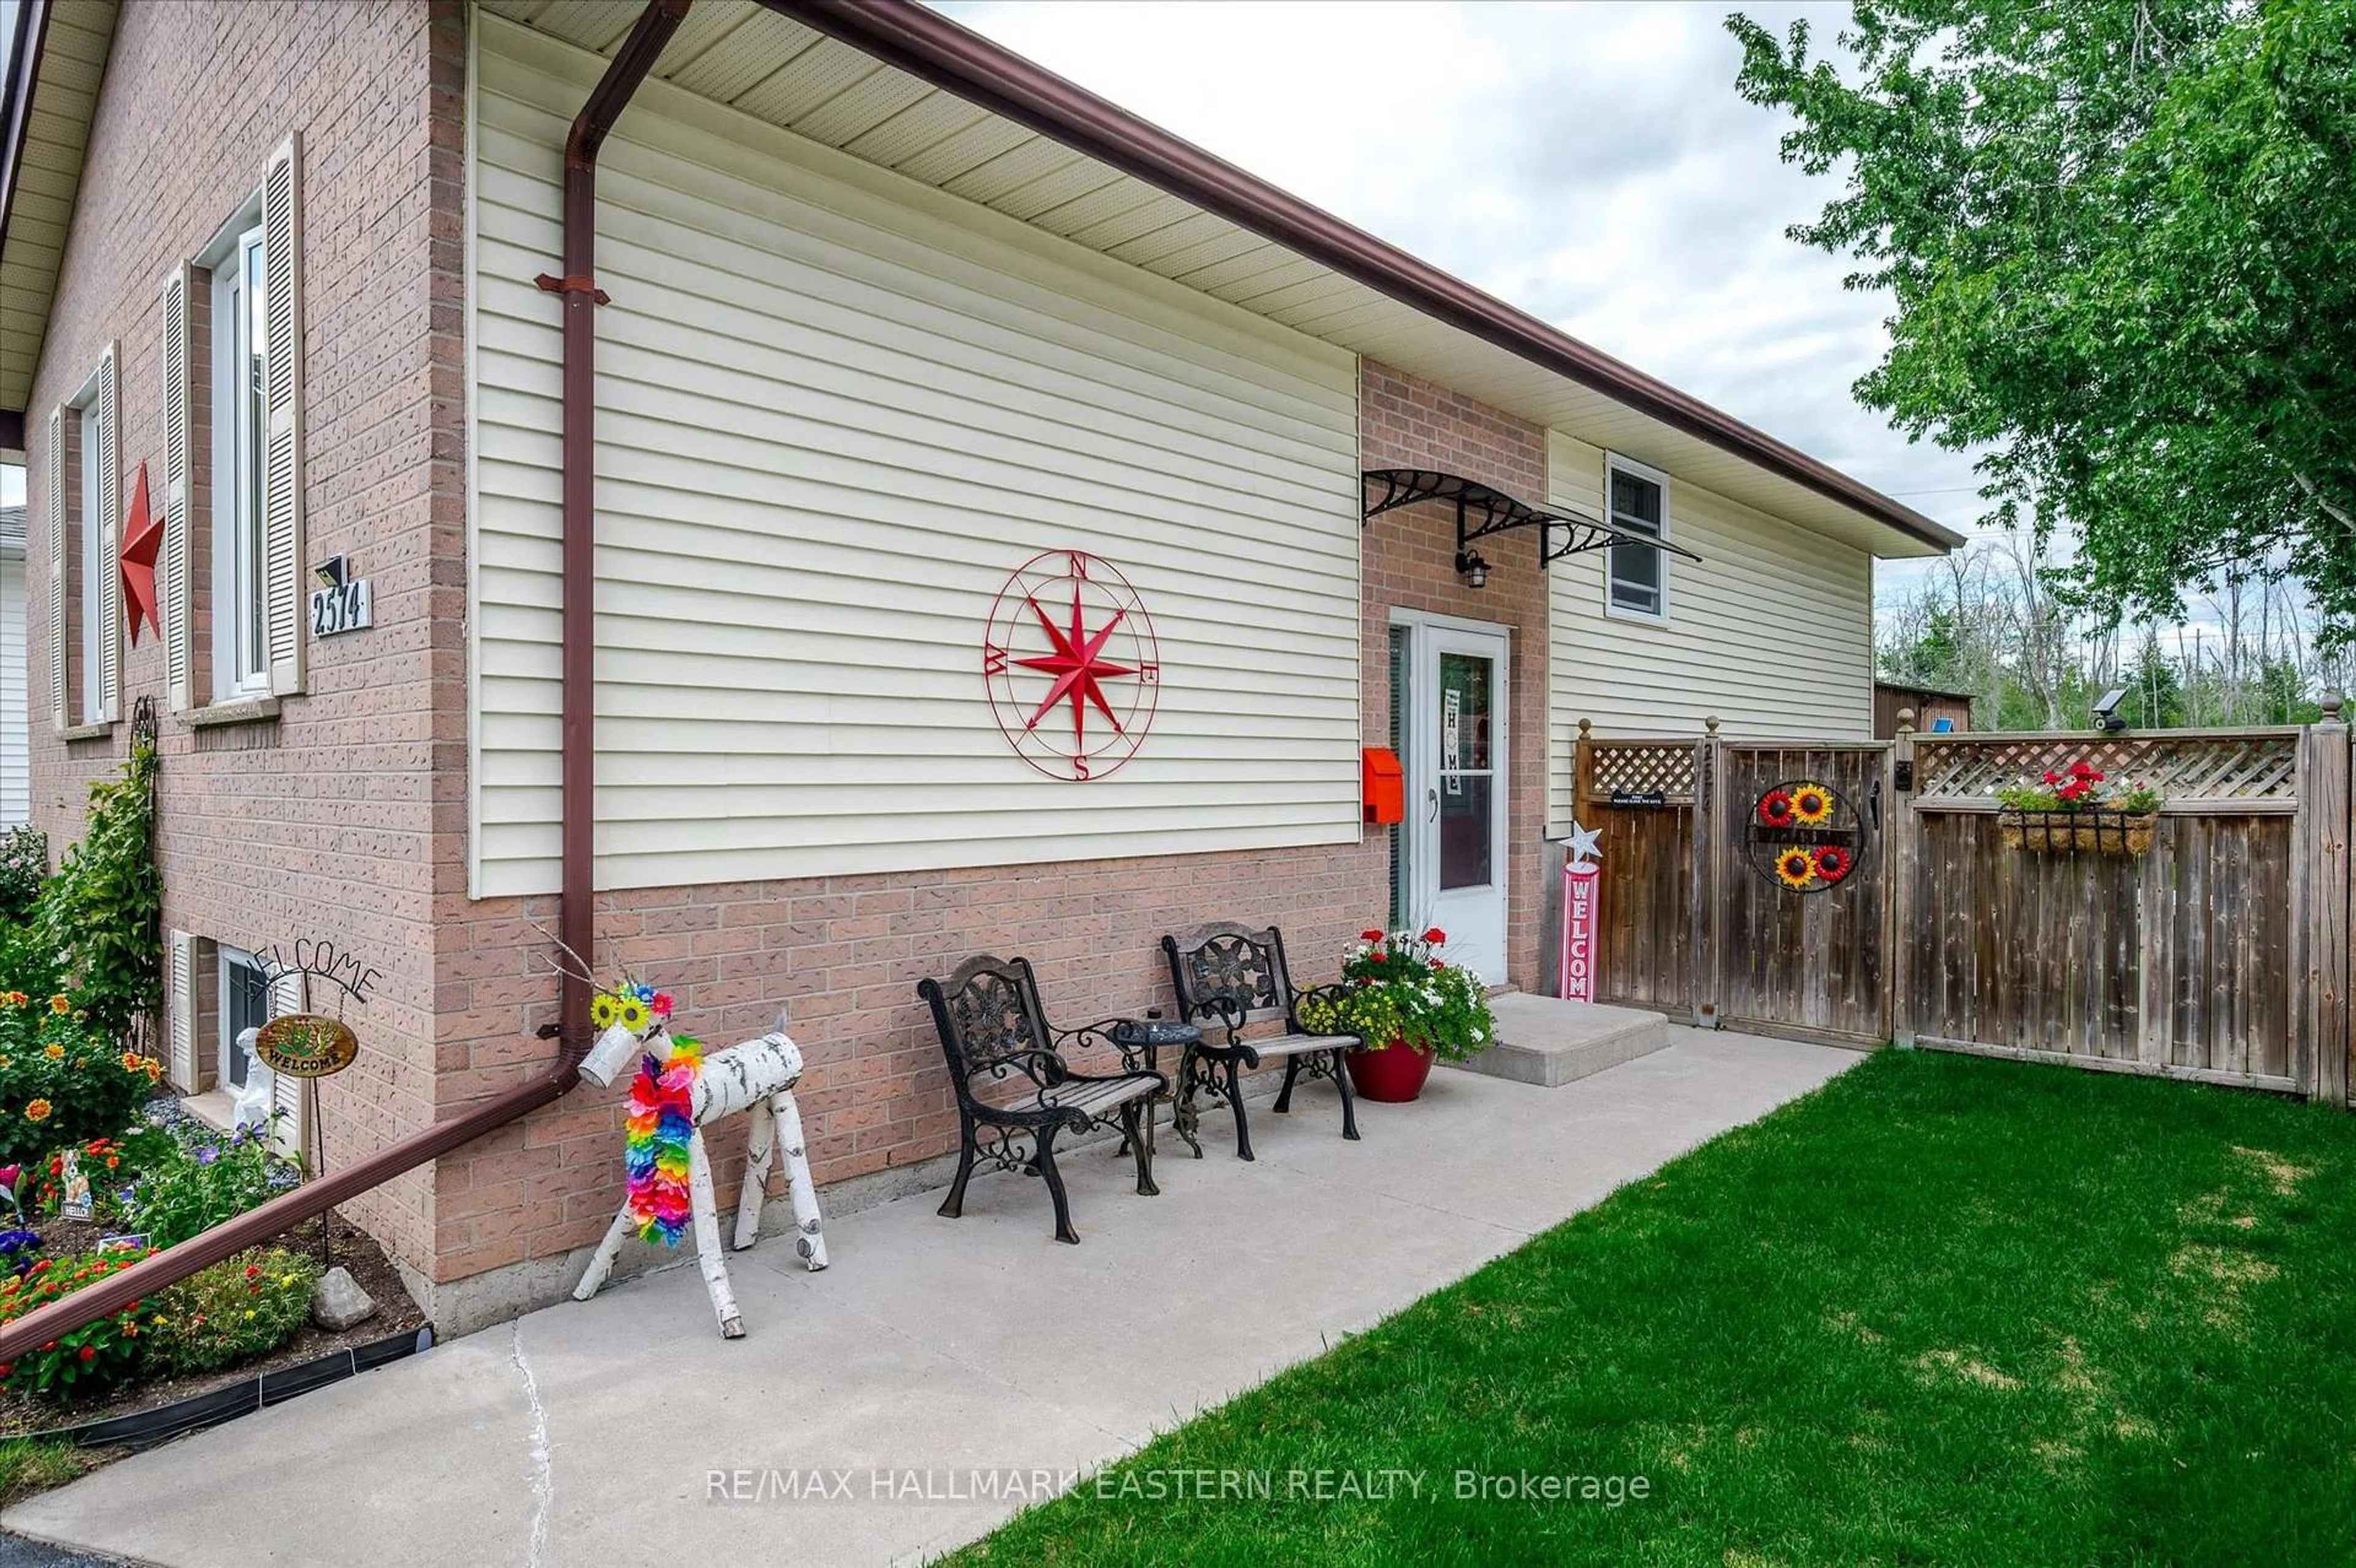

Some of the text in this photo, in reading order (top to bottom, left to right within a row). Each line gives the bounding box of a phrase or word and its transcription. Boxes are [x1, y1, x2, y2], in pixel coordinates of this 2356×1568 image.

[1069, 551, 1088, 579] N
[314, 582, 360, 634] 2574
[1074, 756, 1089, 782] S
[1569, 881, 1590, 1002] WELCOM
[268, 1049, 341, 1071] WELCOME
